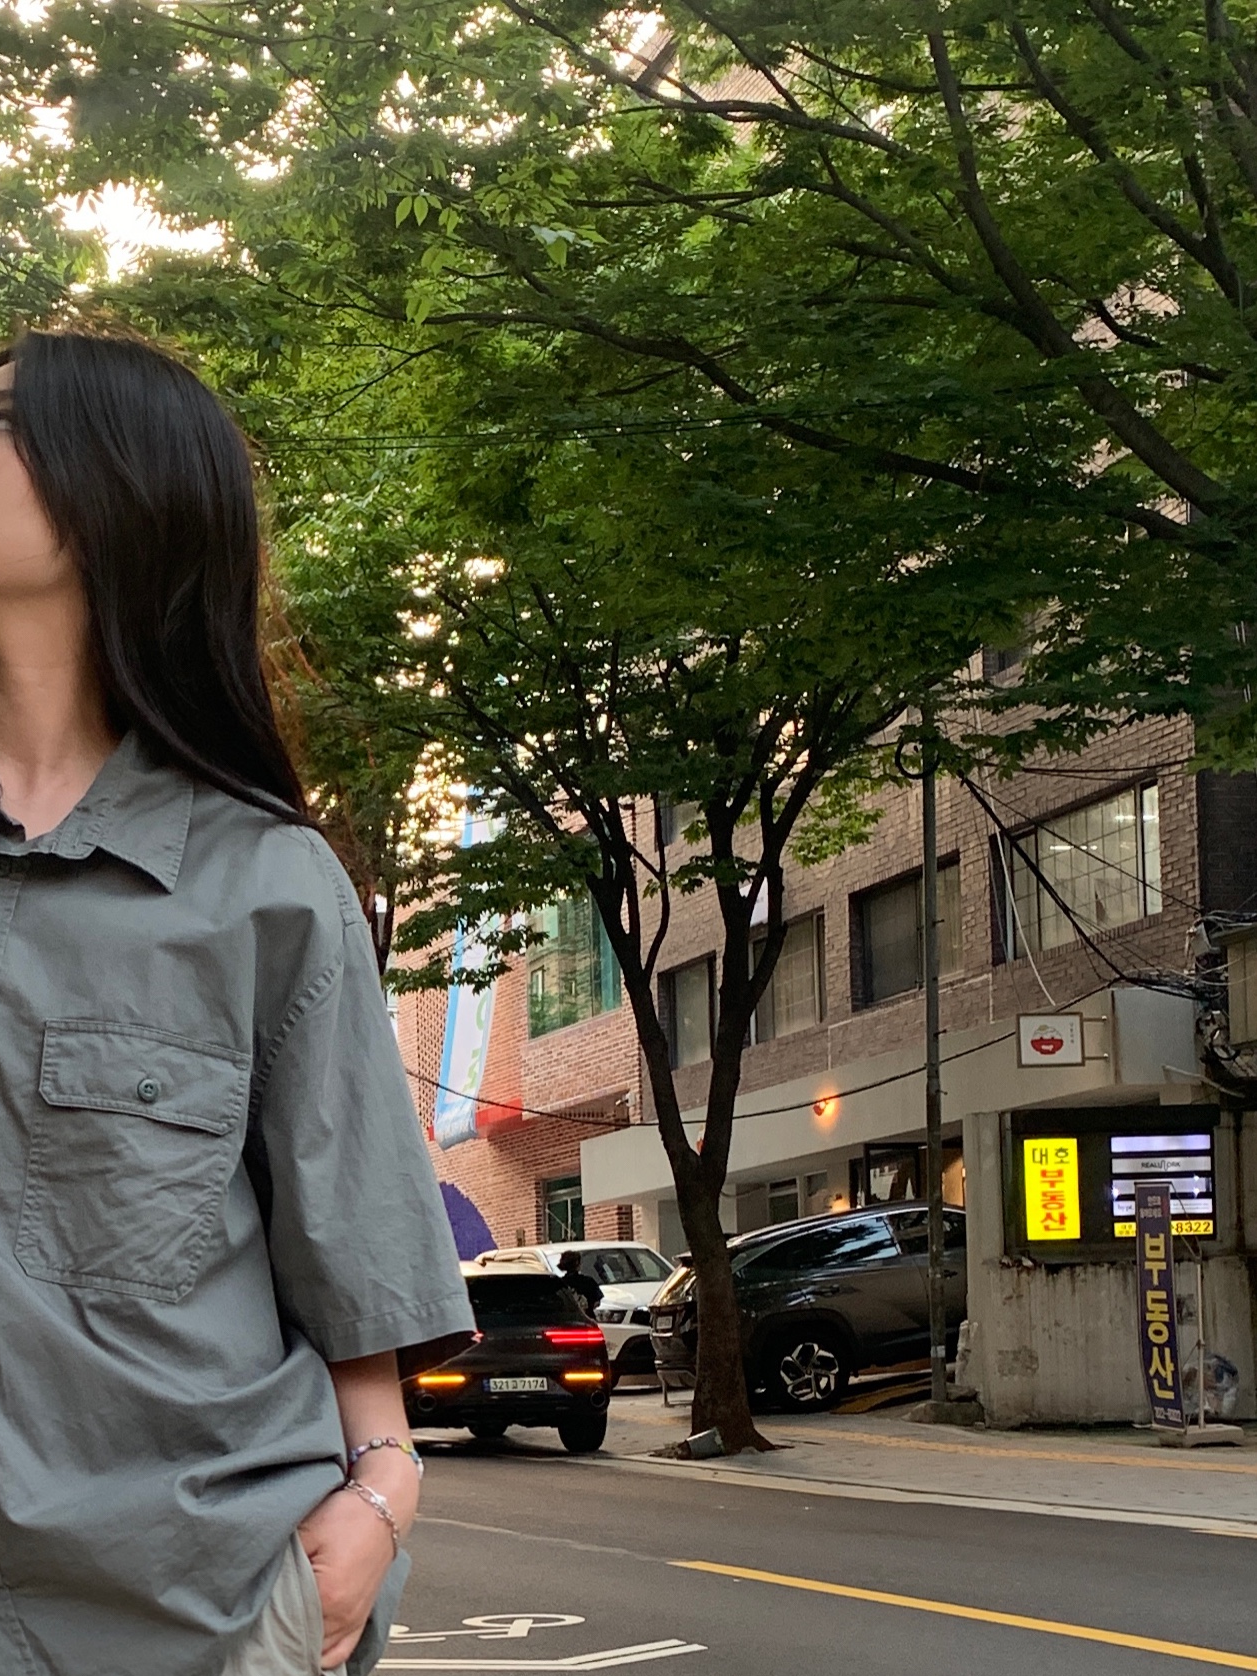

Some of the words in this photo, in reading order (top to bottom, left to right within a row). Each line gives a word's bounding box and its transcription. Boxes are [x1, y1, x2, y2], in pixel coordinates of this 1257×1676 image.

[1031, 1147, 1071, 1166] 대호
[1039, 1169, 1068, 1232] 부동산
[1144, 1232, 1175, 1400] 부동산
